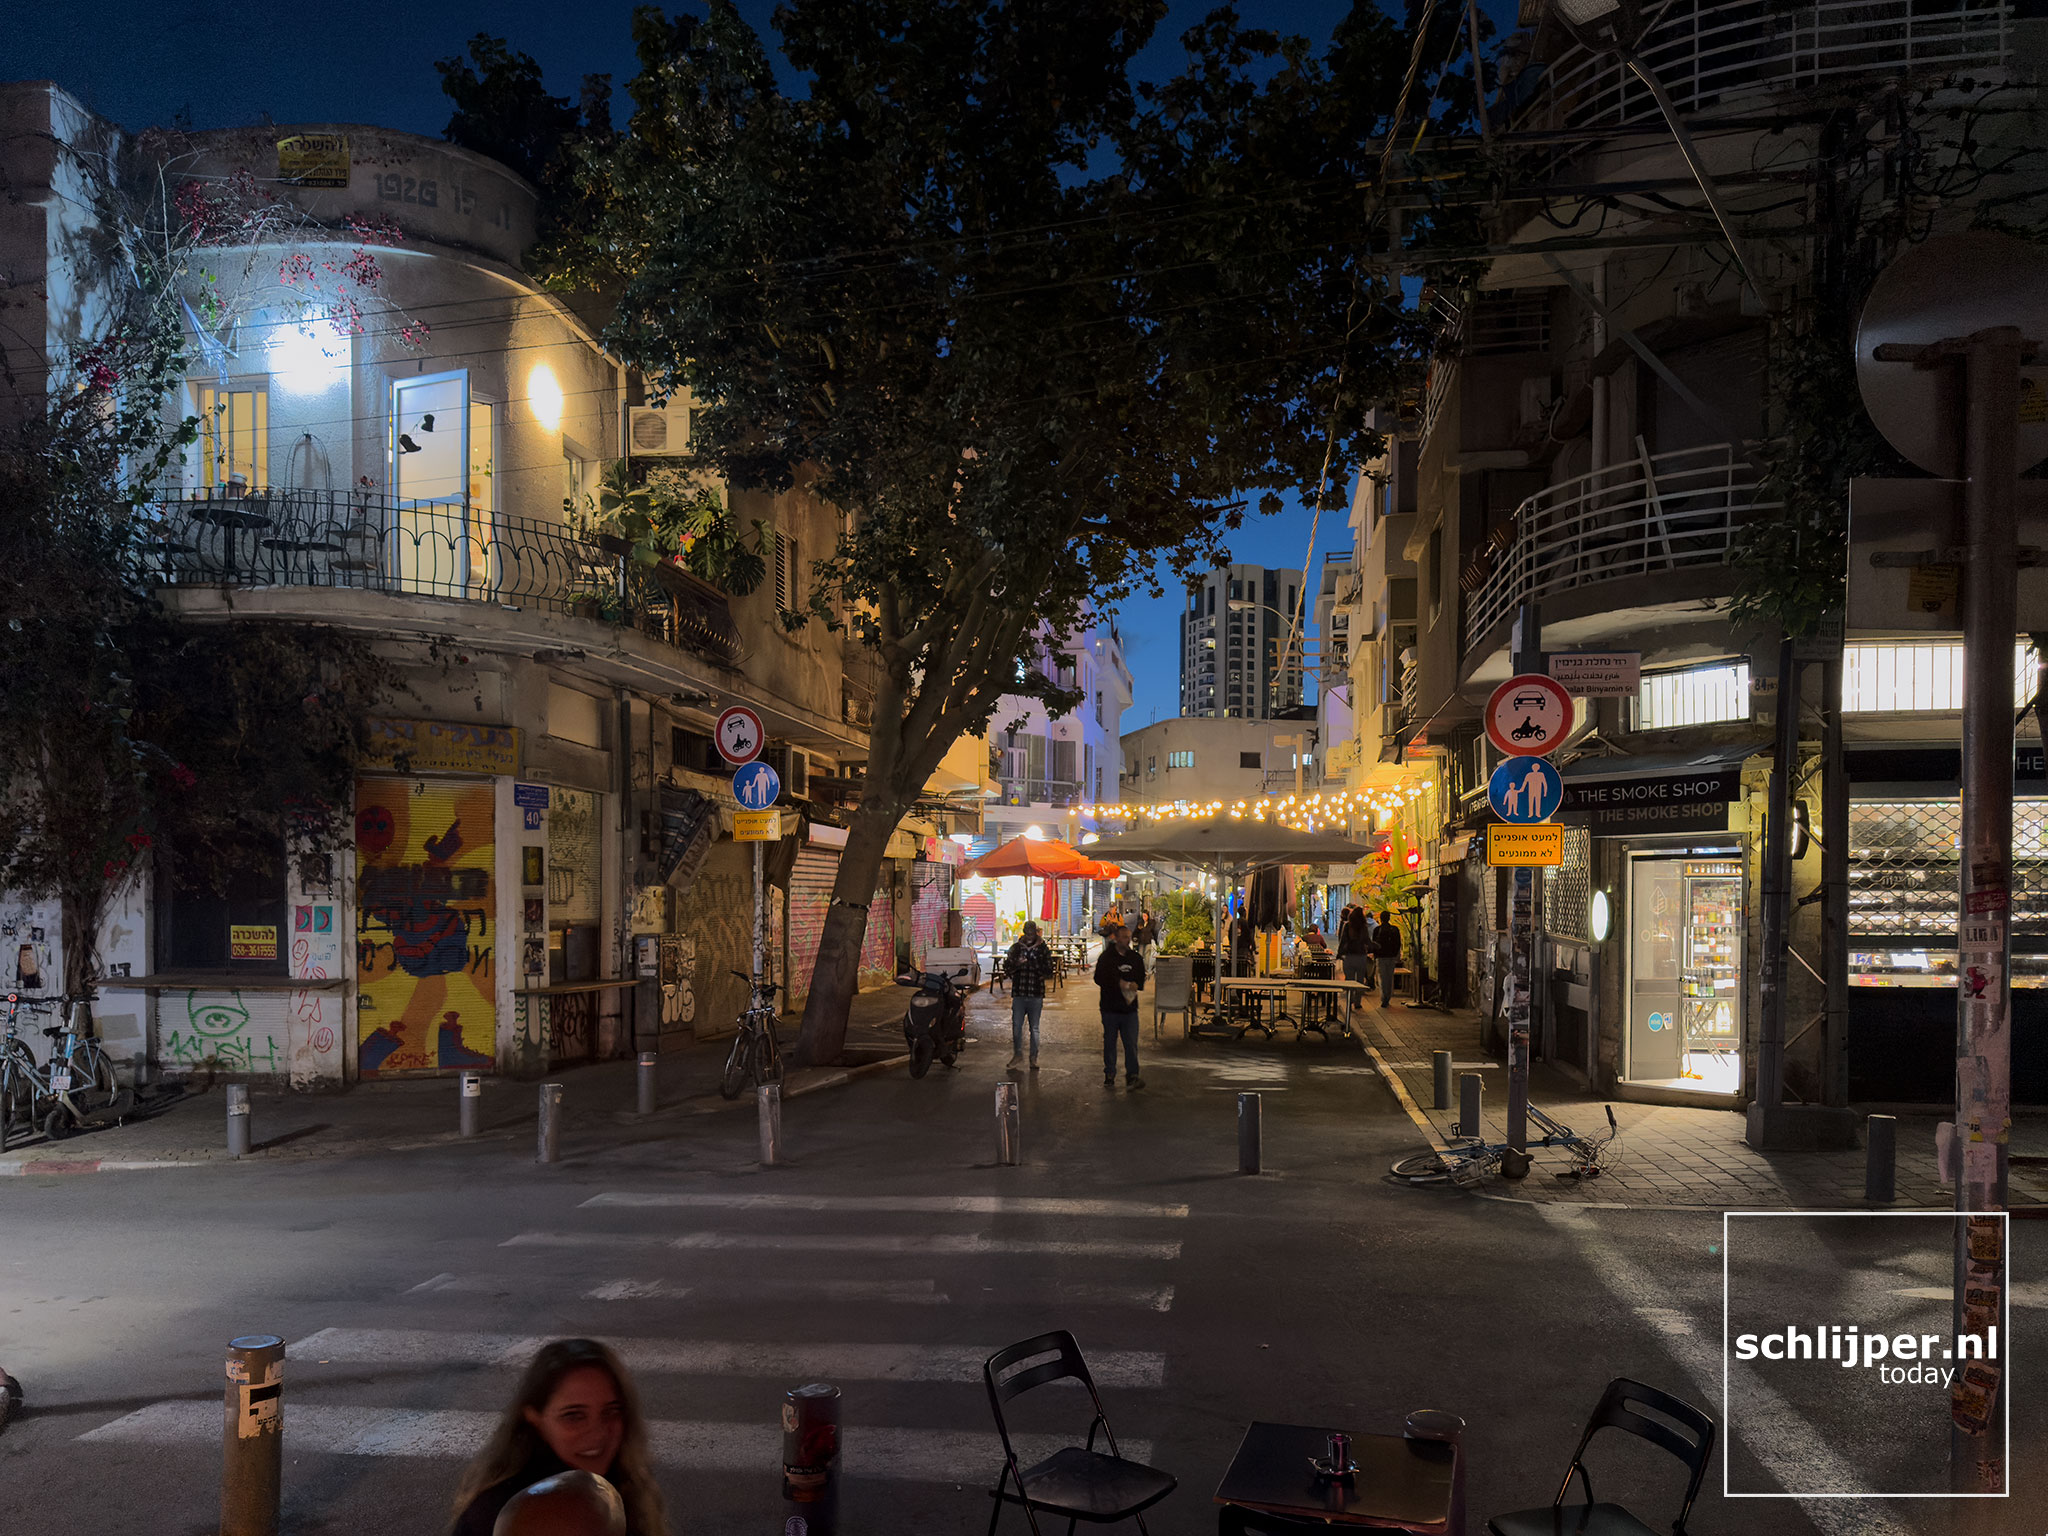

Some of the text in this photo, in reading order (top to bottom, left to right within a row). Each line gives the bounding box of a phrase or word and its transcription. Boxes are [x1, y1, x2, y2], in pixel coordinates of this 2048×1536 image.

[1554, 657, 1583, 669] בנימין
[1585, 656, 1611, 667] נחלת
[1566, 685, 1584, 694] halat
[1586, 685, 1623, 695] Binyamin
[2015, 754, 2045, 771] HE
[1577, 780, 1721, 803] THE SMOKE SHOP
[526, 811, 539, 825] 40
[1598, 802, 1723, 823] THE SMOKE SHOP
[1493, 832, 1558, 842] למעט אופניים
[1498, 848, 1553, 858] לא ממונעים
[232, 928, 275, 940] להשכרה
